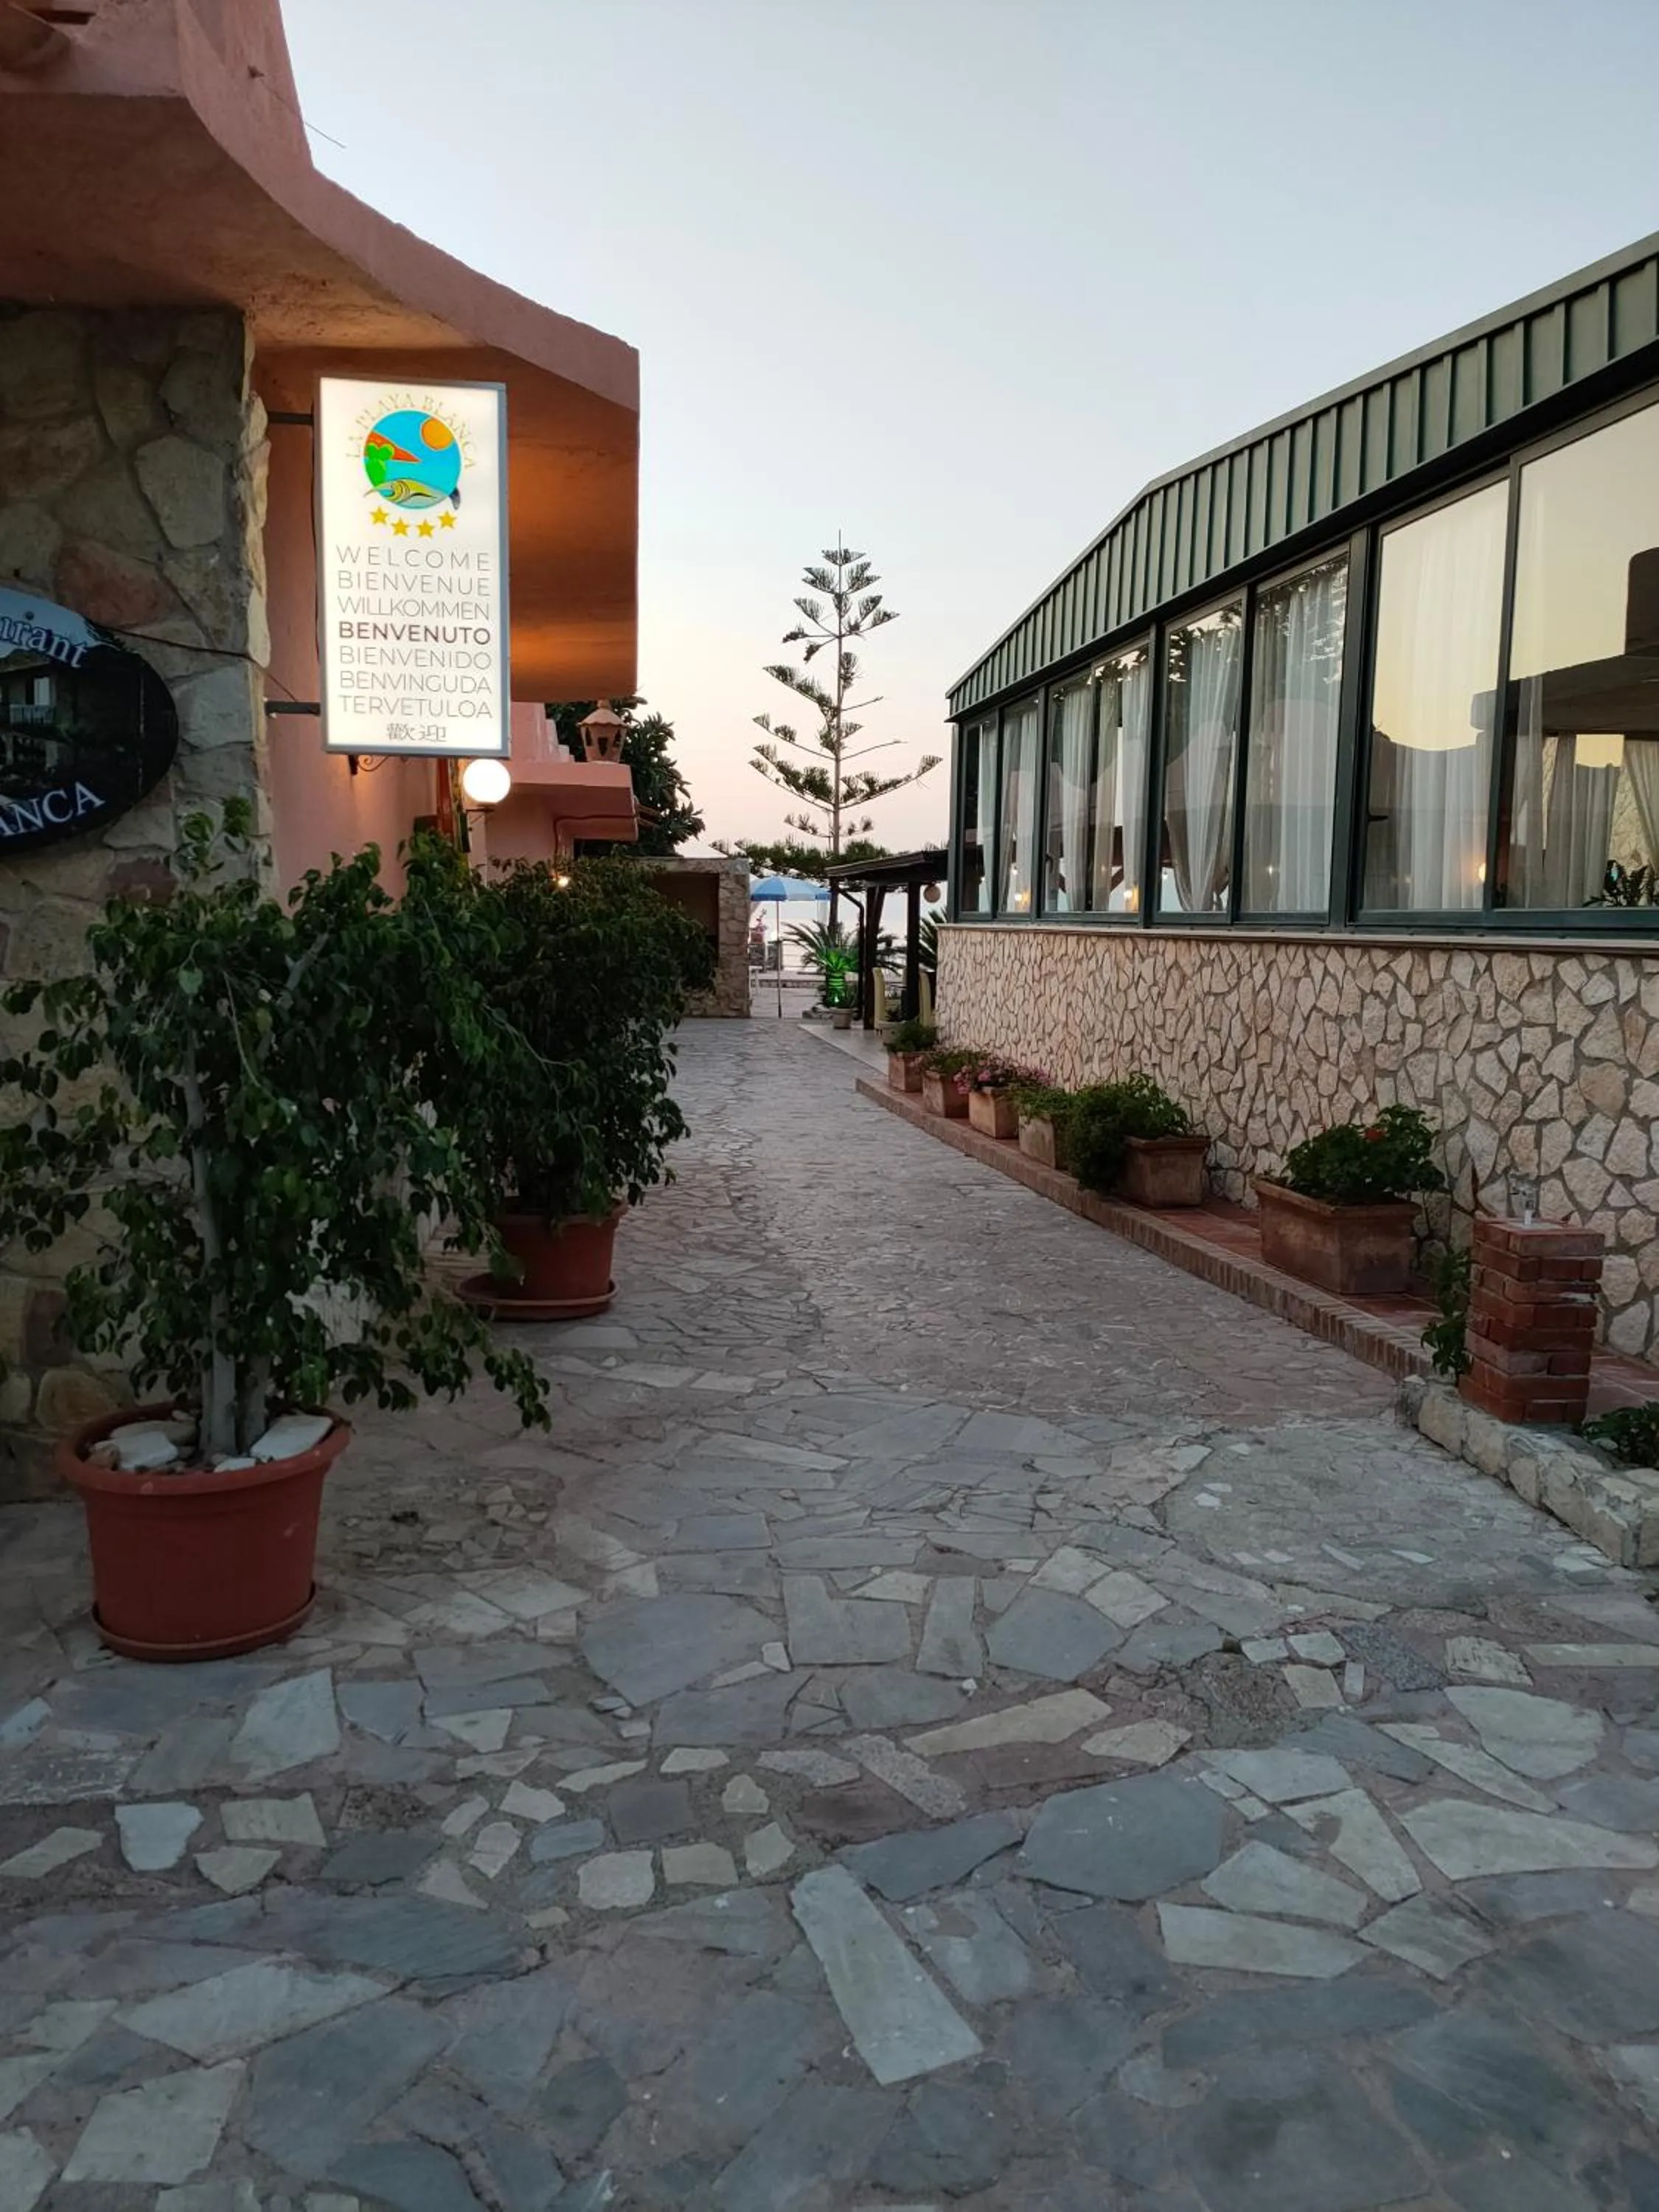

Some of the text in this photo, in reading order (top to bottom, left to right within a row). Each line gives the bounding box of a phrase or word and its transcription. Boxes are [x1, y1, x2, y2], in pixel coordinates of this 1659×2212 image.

[355, 394, 415, 429] PLAYA
[336, 545, 491, 571] WELCOME
[338, 570, 490, 597] BIENVENUE
[338, 596, 490, 620] WILLKOMMEN
[339, 621, 490, 644] BENVENUTO
[340, 645, 492, 670] BIENVENIDO
[340, 670, 492, 695] BENVINGUDA
[339, 695, 493, 718] TERVETULOA
